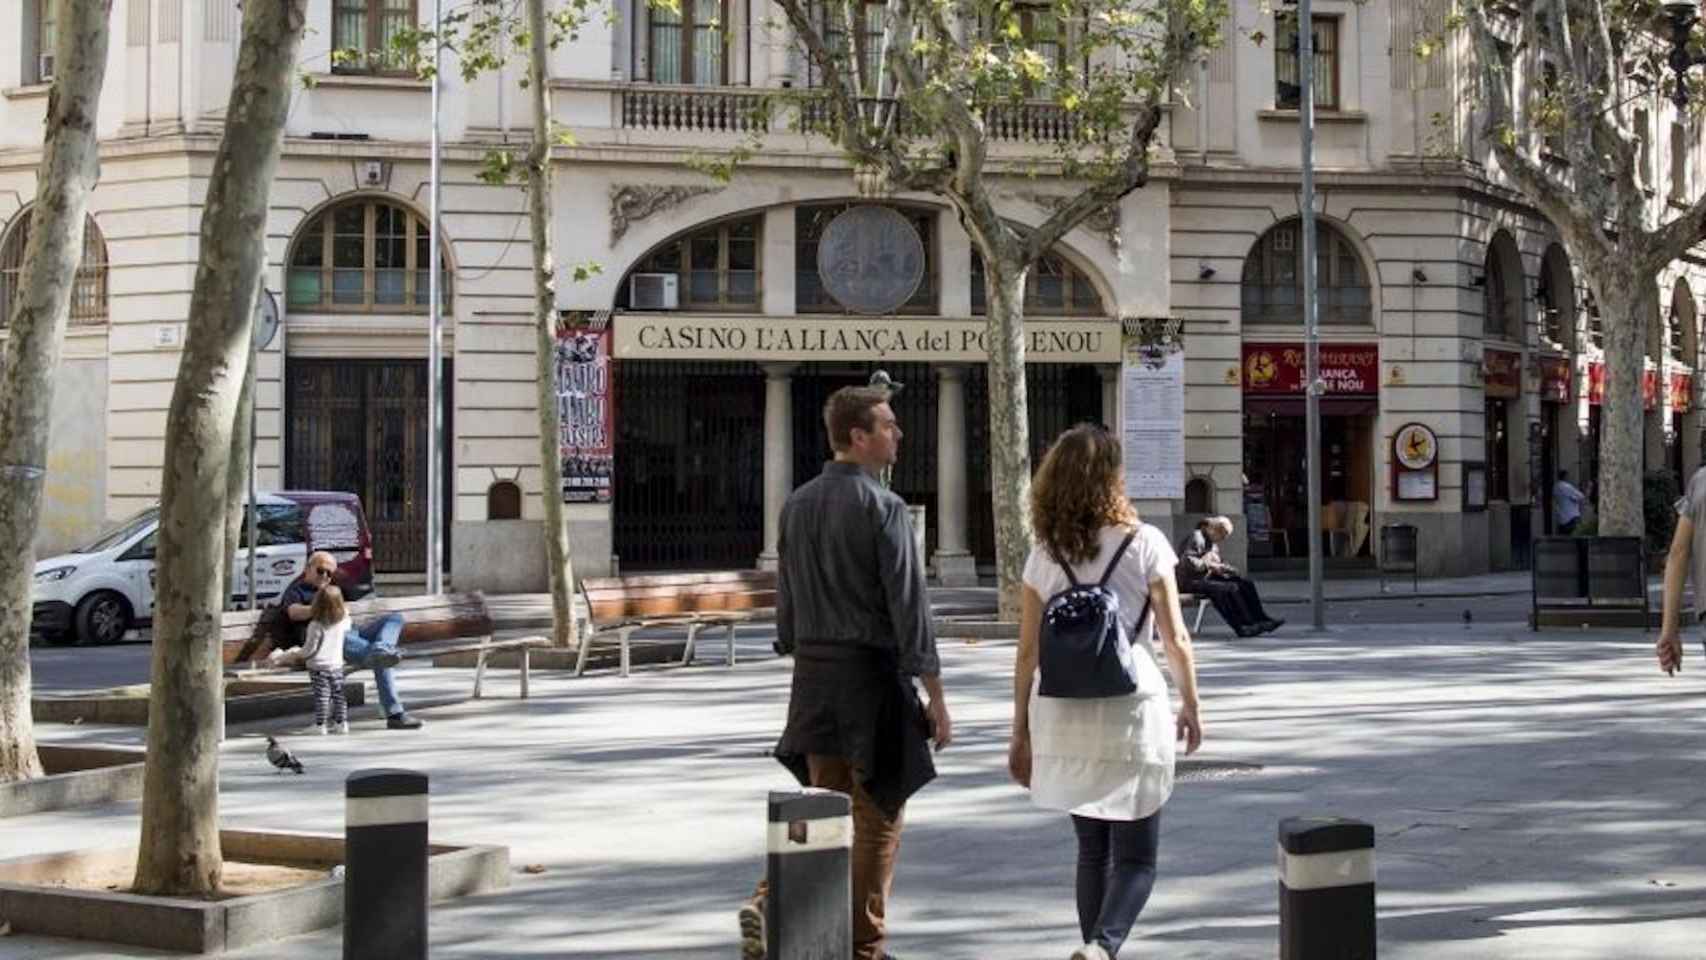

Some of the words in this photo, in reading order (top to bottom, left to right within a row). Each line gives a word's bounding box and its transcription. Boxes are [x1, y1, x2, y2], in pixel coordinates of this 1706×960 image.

[638, 325, 746, 349] CASINO
[756, 327, 908, 356] L'ALIANÇA
[916, 329, 950, 351] del
[1337, 380, 1364, 391] NOU
